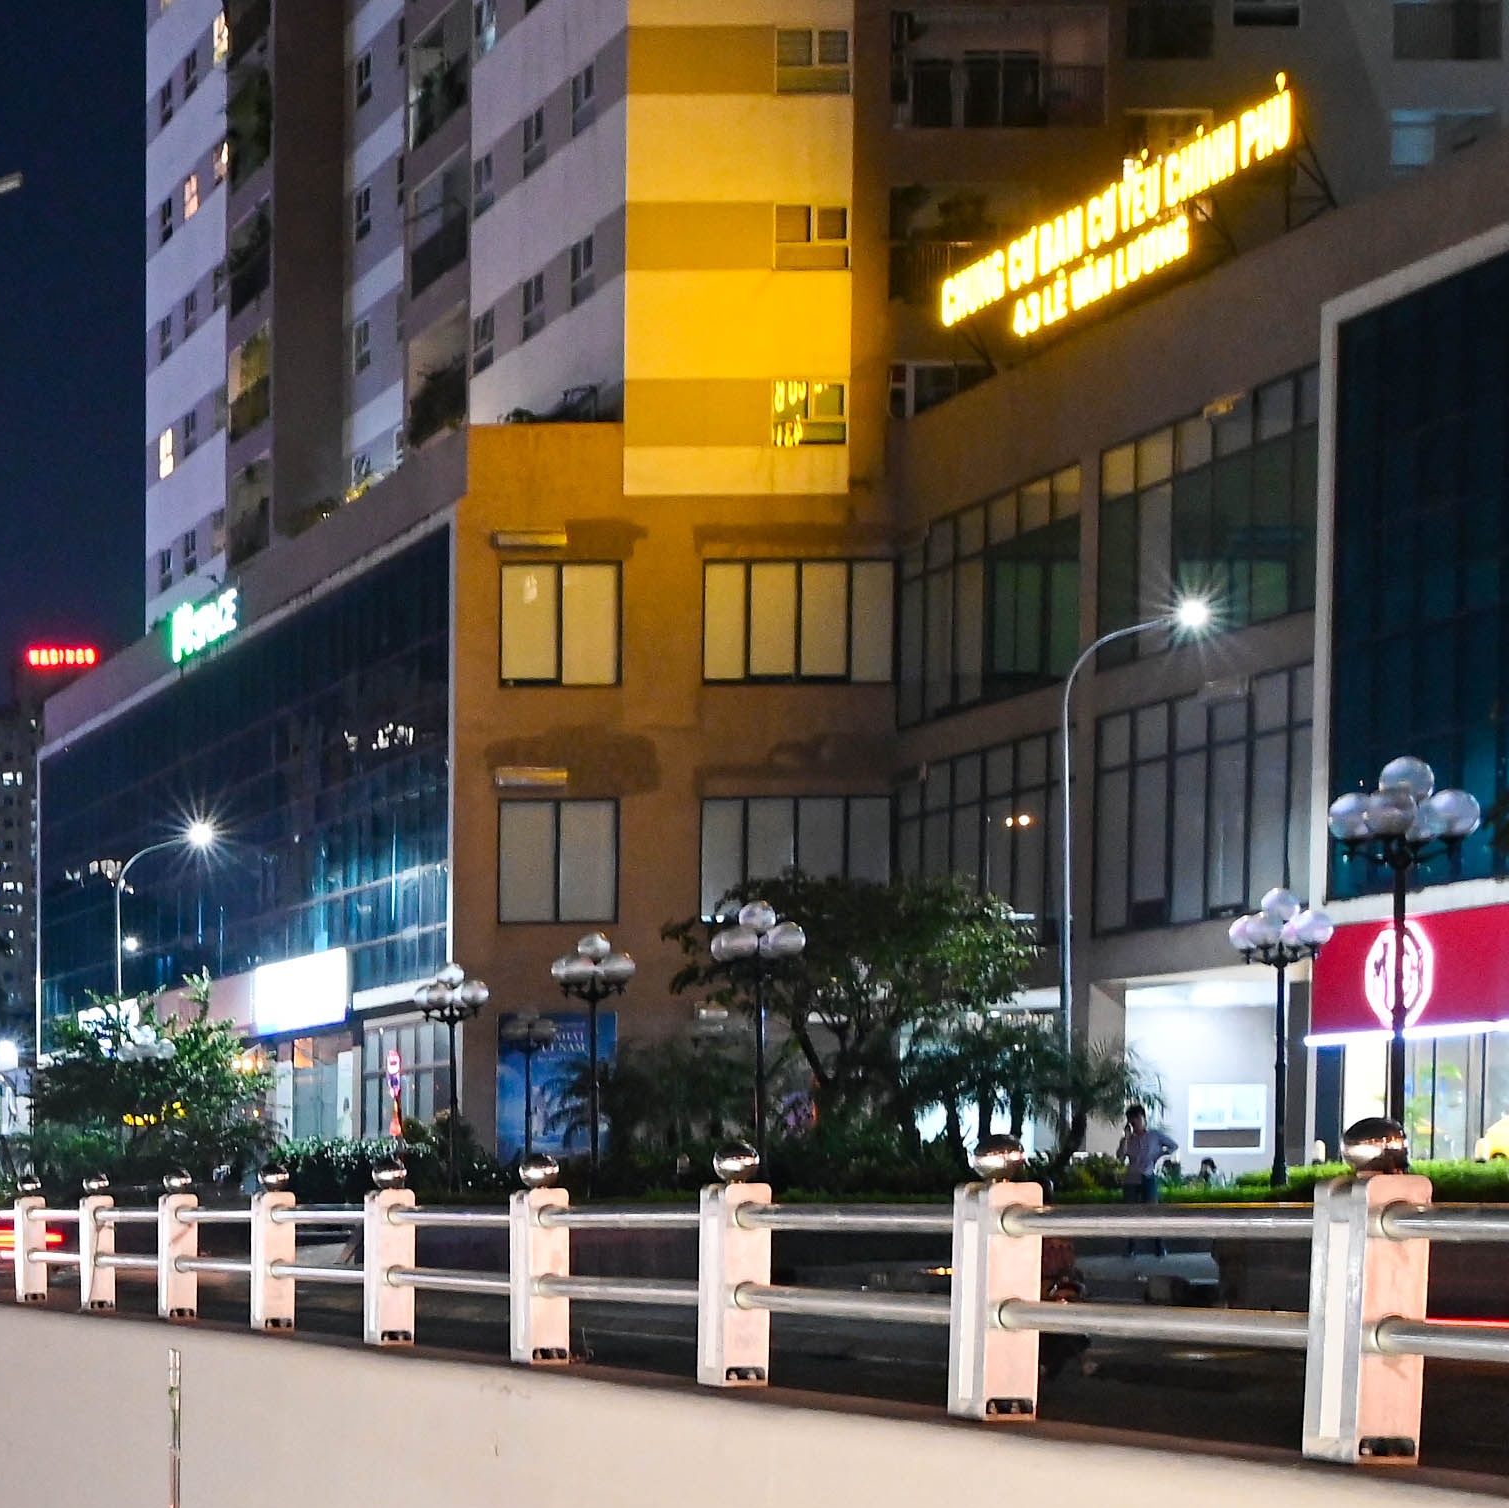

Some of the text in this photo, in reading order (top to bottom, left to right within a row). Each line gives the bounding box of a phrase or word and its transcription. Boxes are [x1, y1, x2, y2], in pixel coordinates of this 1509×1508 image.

[941, 249, 1005, 328] CHUNG
[1038, 205, 1083, 277] BAN
[1086, 181, 1118, 251] CƠ
[1164, 120, 1238, 208] CHÍNH
[1239, 71, 1292, 169] PHỦ
[1042, 267, 1069, 326] LÊ
[1069, 252, 1113, 311] VĂN
